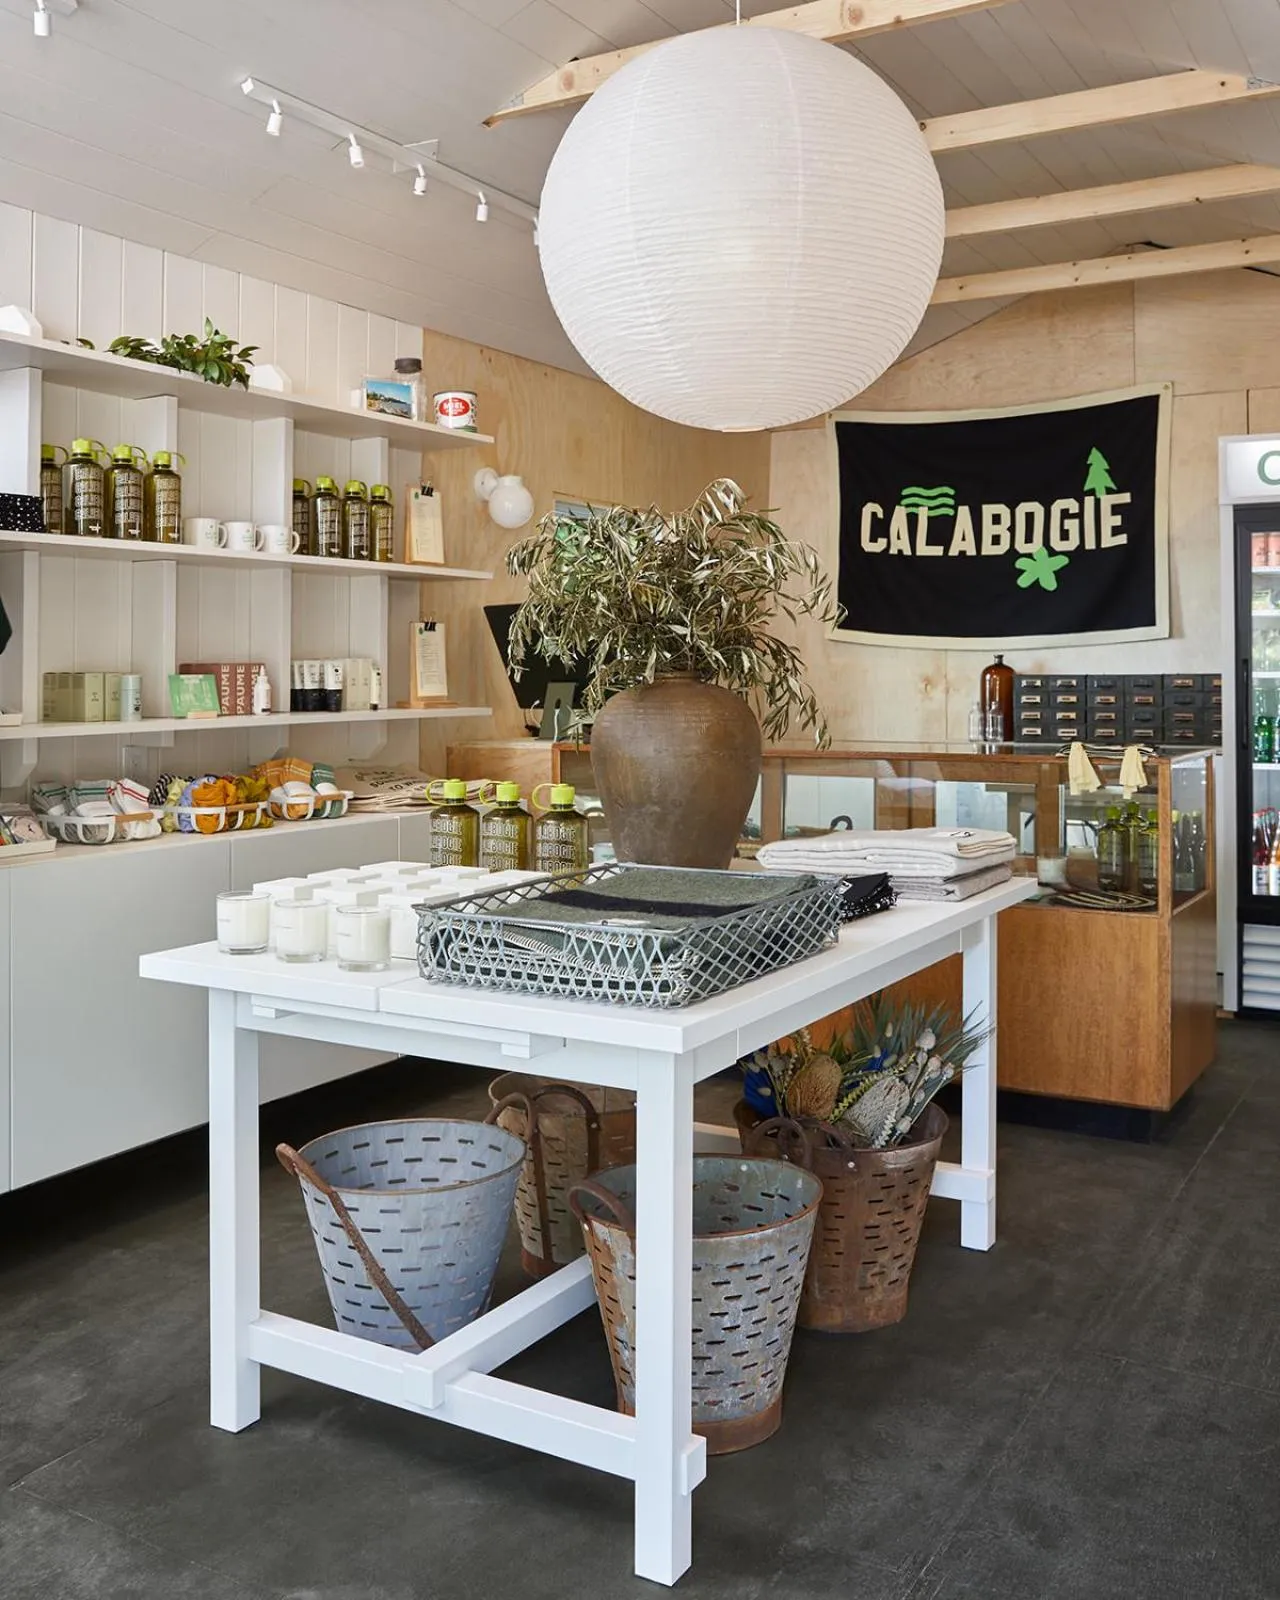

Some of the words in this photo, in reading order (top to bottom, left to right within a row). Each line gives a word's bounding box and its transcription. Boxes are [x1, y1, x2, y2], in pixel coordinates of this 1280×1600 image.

[861, 492, 1131, 556] CALABOGIE
[221, 664, 230, 714] PAUME
[236, 664, 246, 714] PAUME
